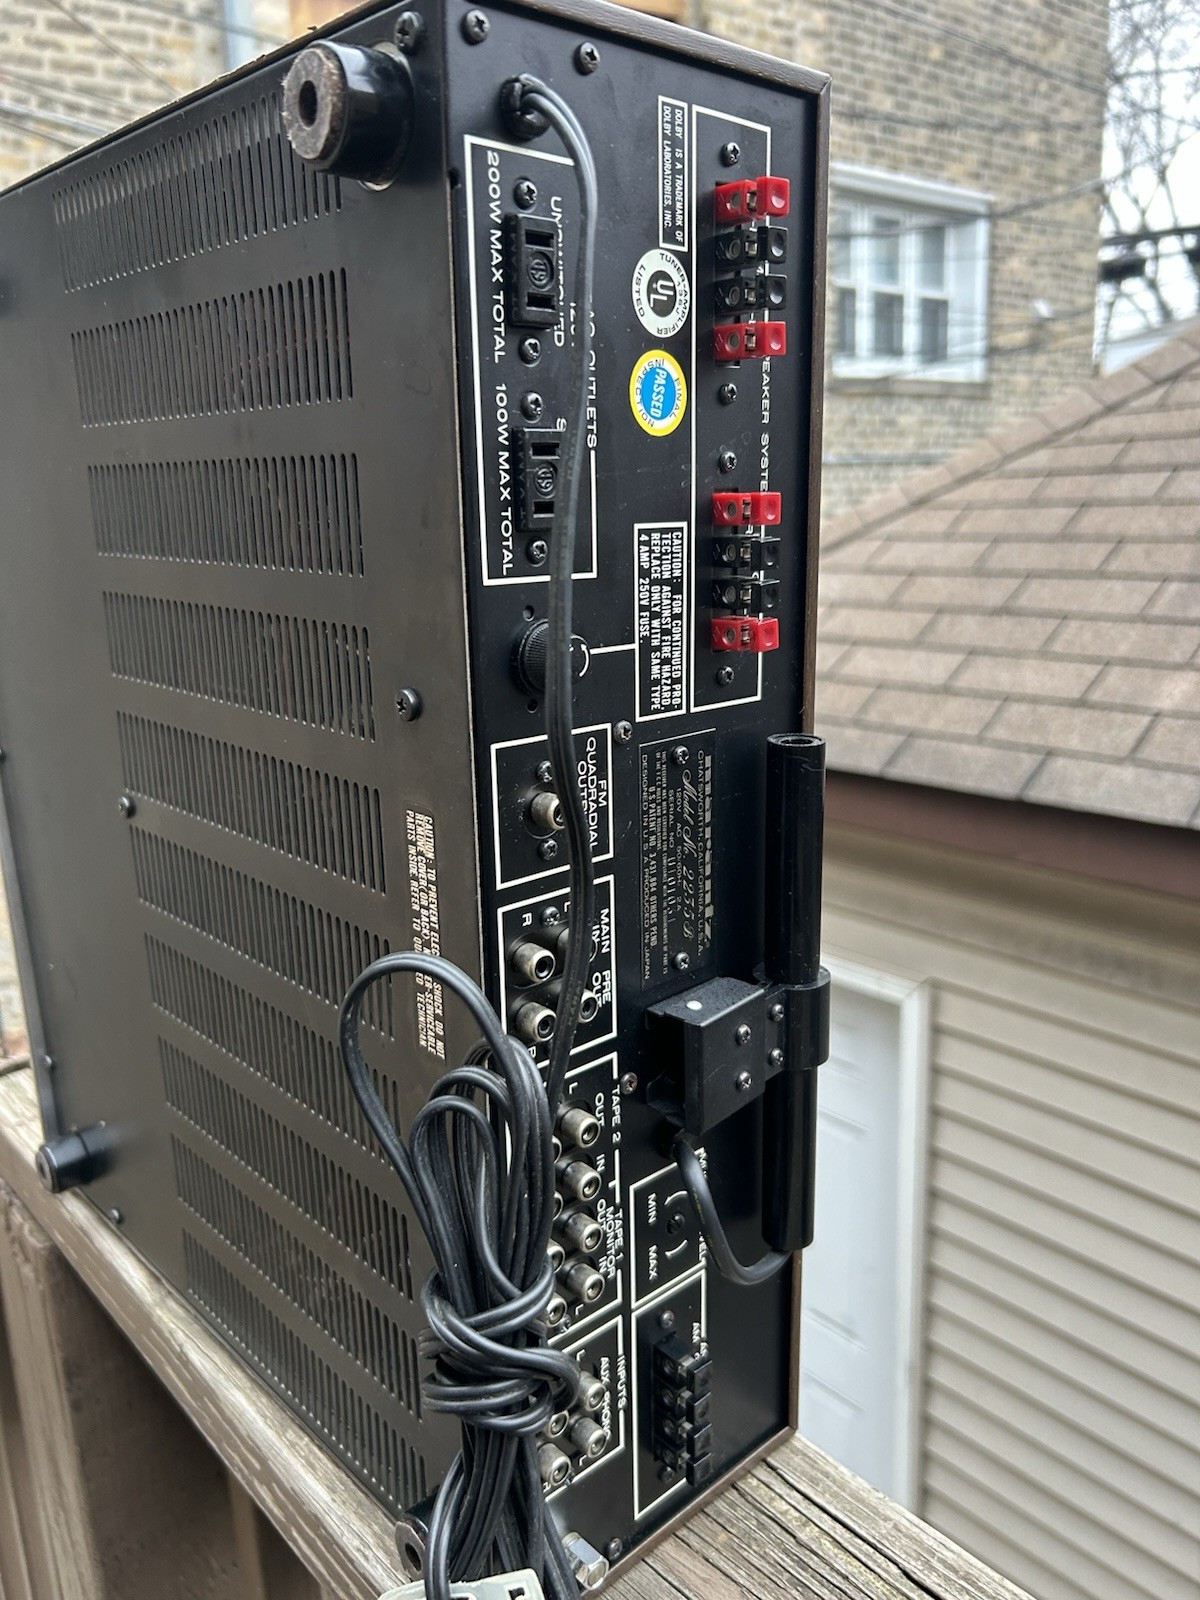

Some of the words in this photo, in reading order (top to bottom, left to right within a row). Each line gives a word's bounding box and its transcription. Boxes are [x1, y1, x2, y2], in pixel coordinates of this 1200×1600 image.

[663, 105, 672, 136] DOLBY
[675, 109, 683, 139] DOLBY
[675, 148, 683, 158] IS
[486, 150, 502, 224] 200W
[675, 174, 683, 226] TRADEMARK
[675, 230, 683, 243] OF
[489, 229, 504, 283] MAX
[635, 264, 646, 317] LISTED
[650, 279, 674, 308] UL
[657, 252, 689, 335] TUNER-AMPLIFIER
[491, 290, 506, 364] TOTAL
[635, 358, 665, 428] INSPECTION
[650, 367, 668, 418] PASSED
[669, 377, 682, 418] FINAL
[495, 383, 510, 446] 100W
[497, 450, 512, 501] MAX
[500, 506, 514, 576] TOTAL
[639, 545, 649, 569] AMP
[650, 532, 660, 580] REPLACE
[661, 532, 671, 579] TECTION
[671, 531, 682, 583] CAUTION:
[639, 577, 649, 607] 250V
[650, 586, 660, 612] ONLY
[661, 585, 671, 629] AGAINST
[672, 594, 682, 614] FOR
[639, 611, 649, 644] FUSE.
[650, 618, 660, 646] WITH
[661, 635, 671, 659] FIRE
[671, 619, 682, 678] CONTINUED
[650, 651, 660, 681] SAME
[650, 685, 660, 710] TYPE
[660, 664, 671, 711] HAZARD.
[672, 684, 682, 709] PRO-
[586, 736, 598, 852] QUADRADIAL
[598, 779, 607, 807] FM
[682, 769, 697, 825] Model
[406, 809, 416, 841] PARTS
[415, 812, 426, 852] REMOVE
[424, 815, 435, 863] CAUTION:
[408, 844, 418, 877] INSIDE.
[427, 868, 436, 881] TO
[410, 880, 420, 911] REFER
[428, 883, 439, 930] PREVENT
[649, 895, 657, 923] OTHERS
[412, 917, 421, 931] TO
[522, 914, 532, 928] R
[600, 908, 610, 953] MAIN
[433, 982, 443, 1016] SHOCK
[602, 970, 611, 1004] PRE
[435, 1020, 444, 1035] DO
[436, 1039, 445, 1060] NOT
[569, 1081, 578, 1095] L
[595, 1092, 604, 1126] OUT
[612, 1084, 621, 1126] TAPE
[612, 1131, 621, 1143] 2
[596, 1153, 605, 1172] IN
[648, 1192, 657, 1223] MIN
[605, 1205, 615, 1279] MONITOR
[614, 1208, 623, 1249] TAPE
[598, 1255, 607, 1274] IN
[615, 1252, 624, 1261] 1
[648, 1244, 659, 1281] MAX
[600, 1356, 610, 1385] AUX
[617, 1355, 627, 1410] INPUTS
